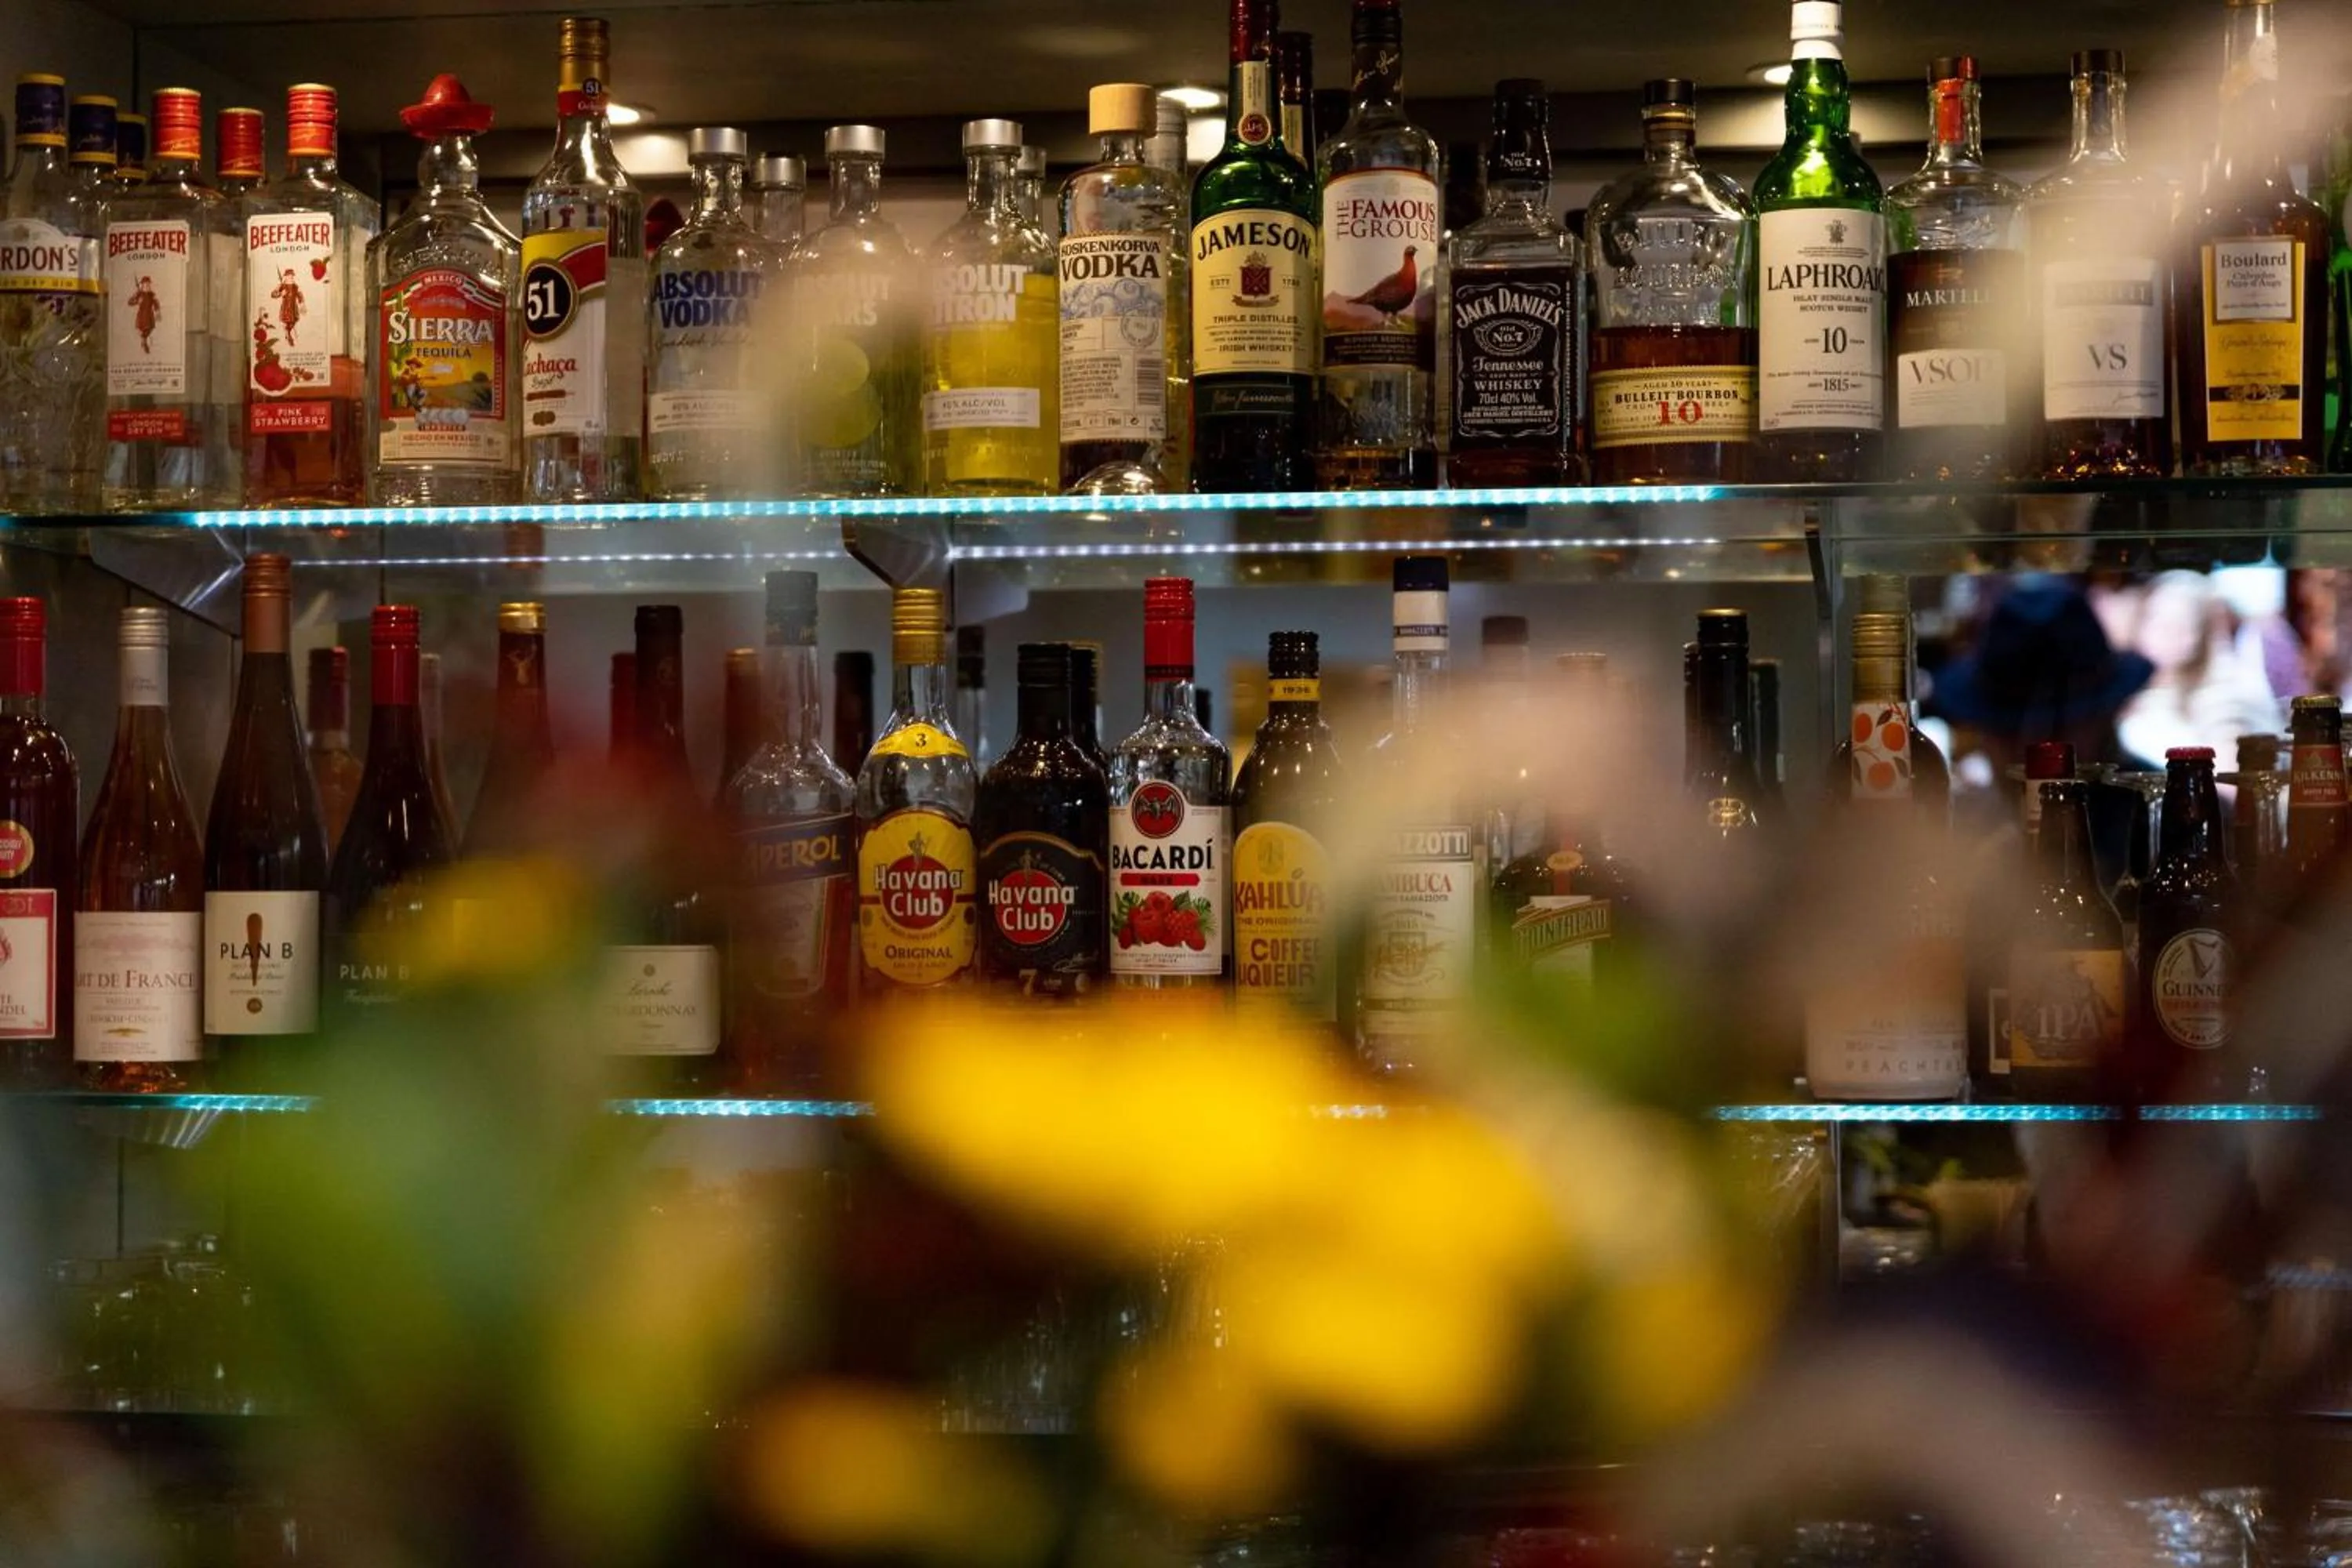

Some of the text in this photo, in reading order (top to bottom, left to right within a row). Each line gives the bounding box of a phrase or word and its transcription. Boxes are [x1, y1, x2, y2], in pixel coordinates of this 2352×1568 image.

[586, 80, 600, 93] 51
[1336, 200, 1351, 240] THE
[1352, 199, 1436, 226] FAMOUS
[250, 223, 330, 249] BEEFEATER
[1197, 221, 1312, 261] JAMESON
[1352, 218, 1436, 243] GROUSE
[110, 230, 187, 258] BEEFEATER
[127, 252, 165, 261] LONDON
[1061, 253, 1160, 281] VODKA
[2221, 251, 2287, 268] Boulard
[423, 274, 463, 285] MEXICO
[652, 270, 762, 301] ABSOLUT
[934, 263, 1027, 294] SOLUT
[526, 279, 560, 321] 51
[934, 293, 1016, 323] ITRON
[1455, 288, 1564, 329] JACK DANIEL'S
[1793, 295, 1818, 303] ISLAY
[1799, 304, 1835, 313] SCOTCH
[659, 298, 751, 328] VODKA
[1213, 315, 1247, 324] TRIPLE
[389, 310, 494, 346] SIERRA
[1493, 332, 1524, 343] No.7
[1821, 326, 1847, 354] 10
[416, 347, 472, 358] TEQUILA
[1218, 343, 1293, 352] IRISH WHISKEY
[2086, 343, 2127, 372] VS
[1472, 356, 1544, 372] Tennessee
[1910, 357, 1992, 385] VSOP
[1474, 379, 1543, 391] WHISKEY
[1615, 390, 1738, 404] BULLEIT BOURBON
[1824, 378, 1849, 391] 1815
[254, 416, 325, 427] STRAWBERRY
[278, 408, 302, 416] PINK
[1656, 401, 1704, 425] 10
[915, 733, 927, 748] 3
[1112, 838, 1213, 870] BACARDÍ
[874, 865, 963, 891] Havana
[1235, 867, 1325, 914] KAHLÚA
[891, 892, 944, 917] Club
[989, 879, 1076, 905] Havana
[1002, 906, 1054, 931] Club
[220, 942, 293, 960] PLAN B
[98, 972, 119, 988] DE
[339, 964, 410, 980] PLAN B
[1019, 969, 1037, 996] 7
[2162, 980, 2233, 996] GUINNE
[2039, 1002, 2102, 1040] IPA
